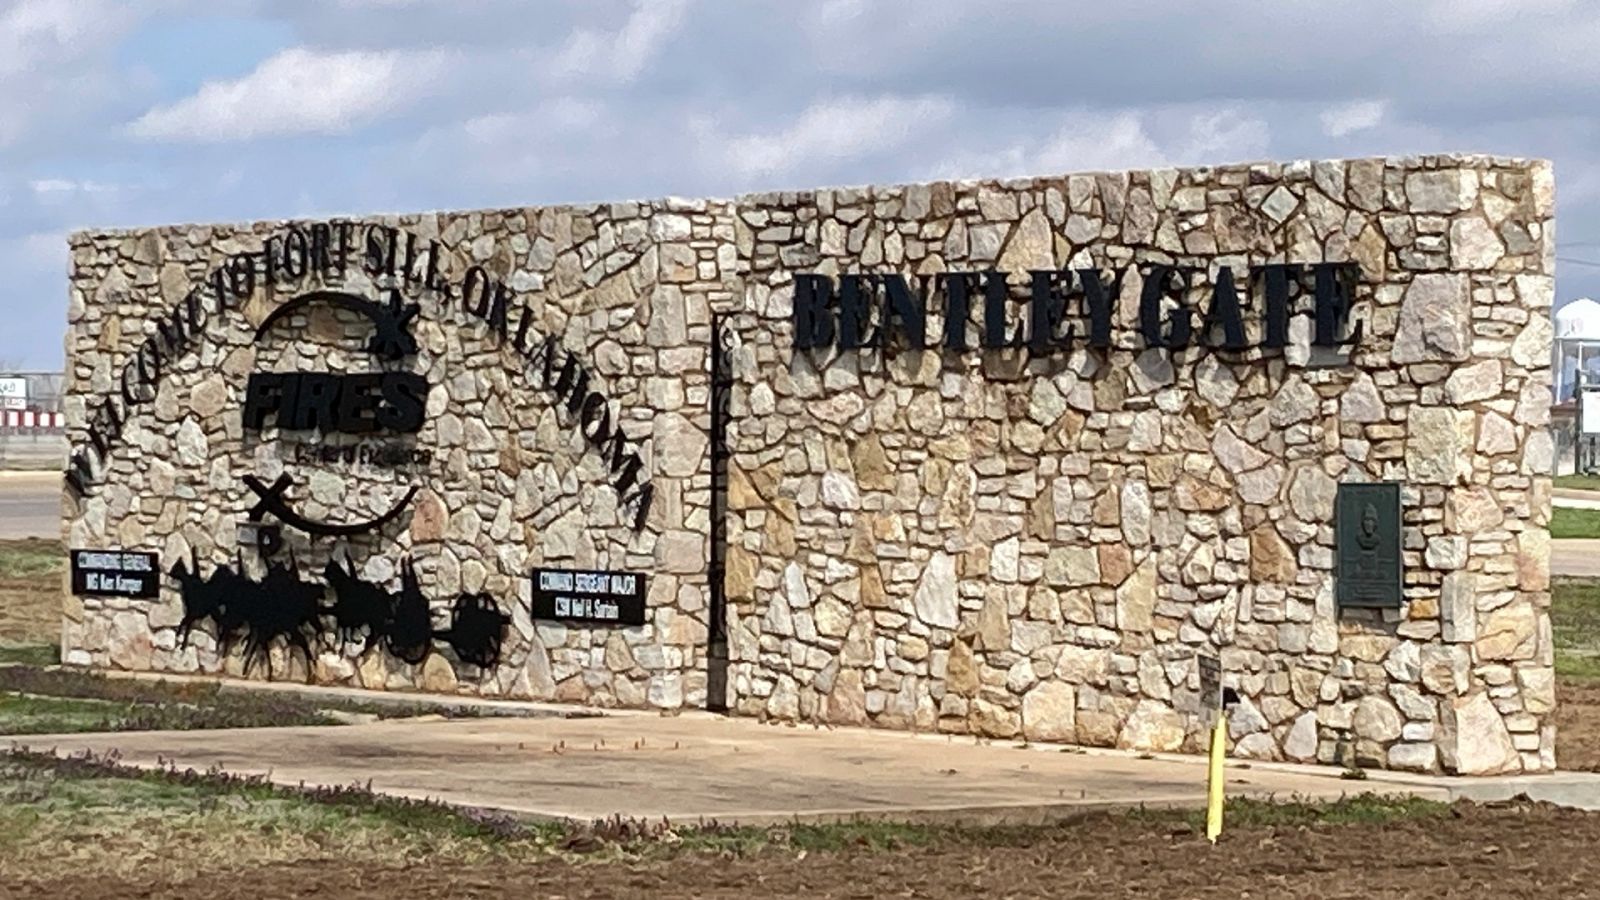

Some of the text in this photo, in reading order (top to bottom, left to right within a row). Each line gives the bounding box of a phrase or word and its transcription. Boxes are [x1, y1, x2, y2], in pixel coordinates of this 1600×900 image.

[211, 254, 253, 315] TO
[263, 218, 364, 283] FORT
[793, 262, 1367, 350] BENTLEY GATE
[243, 371, 429, 433] FIRES
